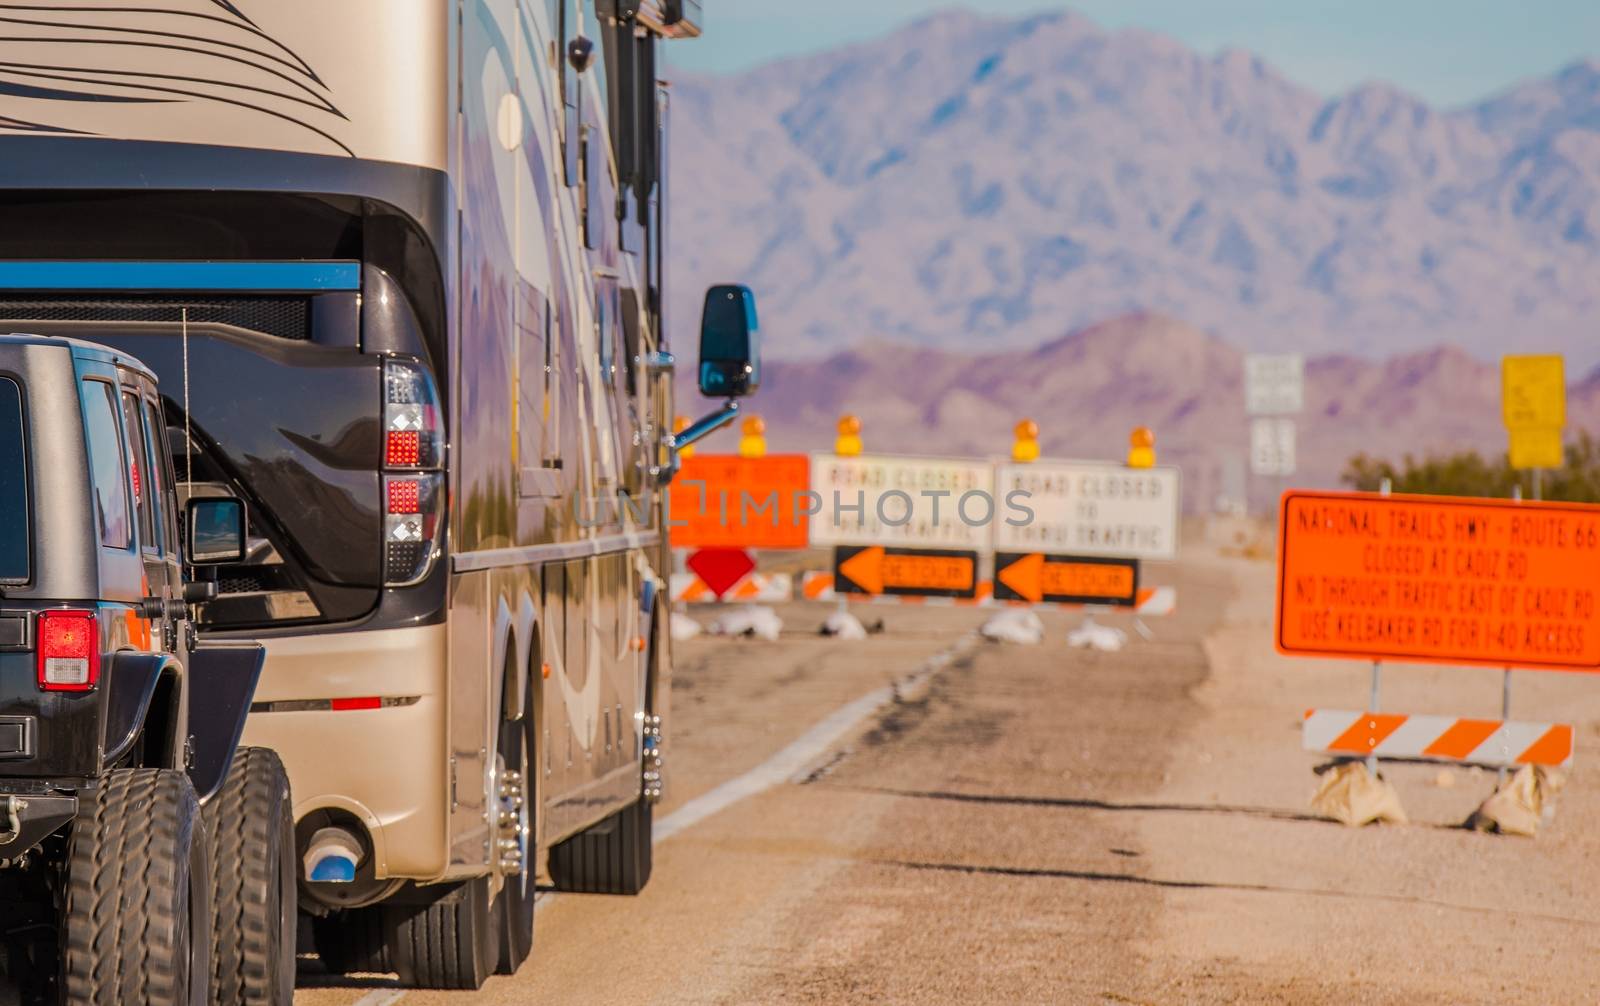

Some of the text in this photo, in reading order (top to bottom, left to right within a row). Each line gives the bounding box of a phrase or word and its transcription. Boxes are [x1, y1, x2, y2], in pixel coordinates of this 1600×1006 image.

[896, 468, 977, 488] CLOSED
[1011, 474, 1163, 500] ROAD CLOSED
[1076, 500, 1098, 519] TO
[1010, 523, 1163, 548] THRU TRAFFIC
[1296, 507, 1381, 538] NATIONAL
[1389, 509, 1447, 540] TRAILS
[1453, 512, 1490, 544] HWY
[1510, 515, 1567, 547] ROUTE
[1575, 517, 1598, 549] 66
[1363, 543, 1529, 582] CLOSED AT CADIZ RD
[1296, 576, 1594, 621] NO THROUGH TRAFFIC EAST OF CADIZ RD
[1299, 611, 1331, 641] USE
[1335, 612, 1417, 645] KELBAKER
[1422, 615, 1443, 647] RD
[1448, 617, 1480, 649] FOR
[1523, 621, 1586, 655] ACCESS
